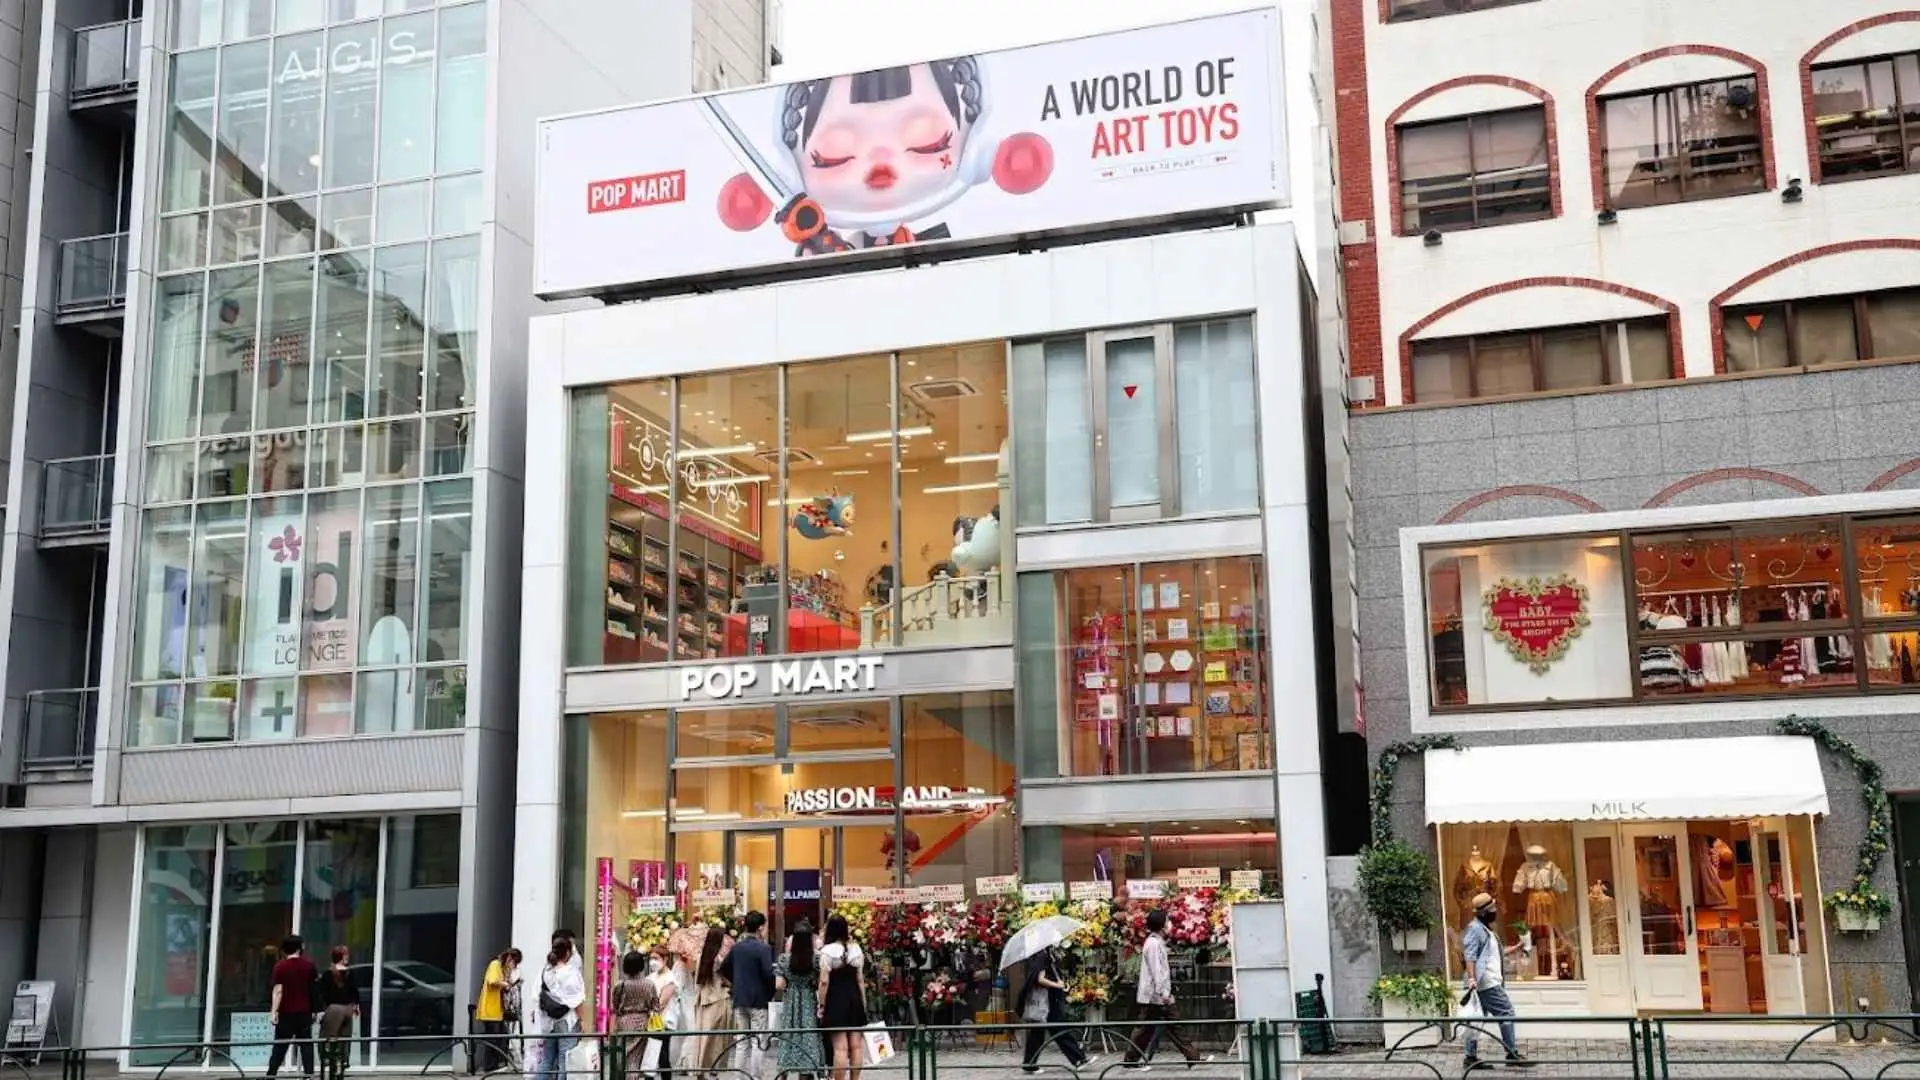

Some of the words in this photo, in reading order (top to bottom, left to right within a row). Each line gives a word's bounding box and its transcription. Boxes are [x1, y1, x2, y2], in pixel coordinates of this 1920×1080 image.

[278, 31, 415, 84] AIGIS
[1041, 85, 1061, 121] A
[1071, 65, 1182, 116] WORLD
[1196, 57, 1234, 98] OF
[1091, 114, 1149, 159] ART
[1158, 103, 1239, 149] TOYS
[591, 183, 626, 209] POP
[631, 176, 681, 204] MART
[274, 643, 348, 665] LONGE
[681, 663, 758, 701] POP
[771, 656, 884, 696] MART
[786, 786, 876, 814] PASSION
[1592, 801, 1649, 816] MILK
